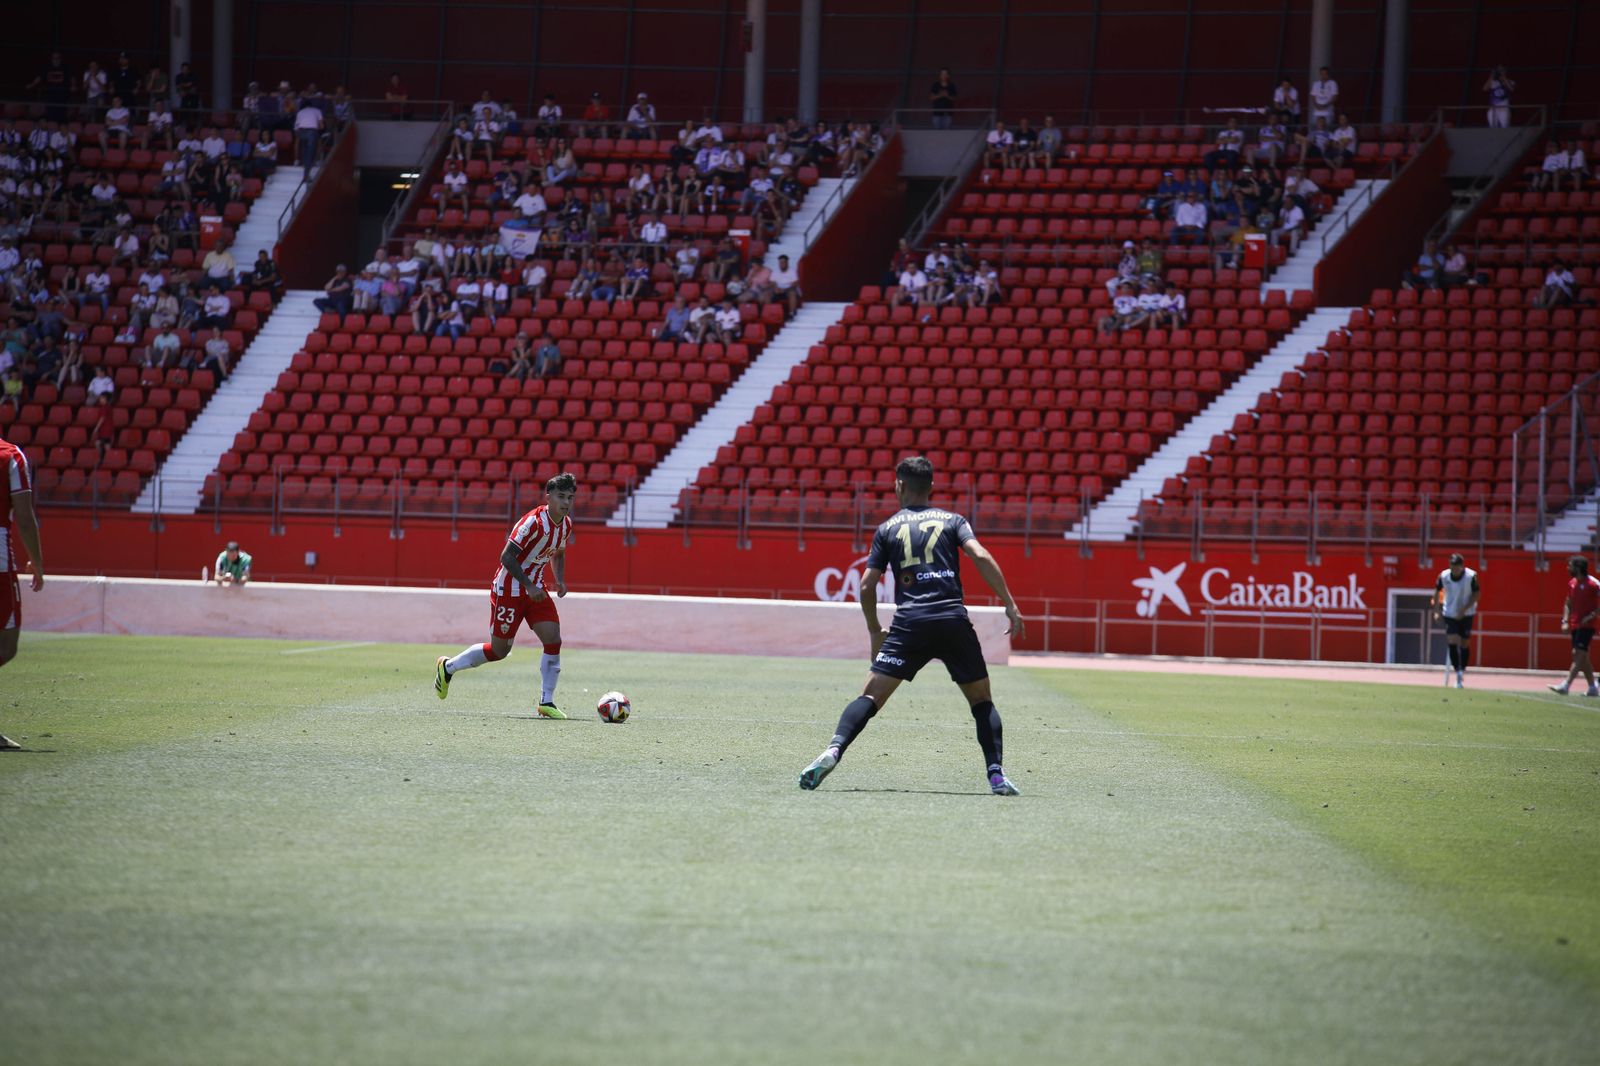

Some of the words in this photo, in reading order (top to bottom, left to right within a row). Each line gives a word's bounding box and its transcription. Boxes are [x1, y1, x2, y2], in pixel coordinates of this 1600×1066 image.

[886, 515, 905, 530] JAVI
[907, 510, 953, 522] MOYANO
[895, 520, 944, 569] 17
[1200, 567, 1367, 609] CaixaBank
[497, 606, 516, 624] 23
